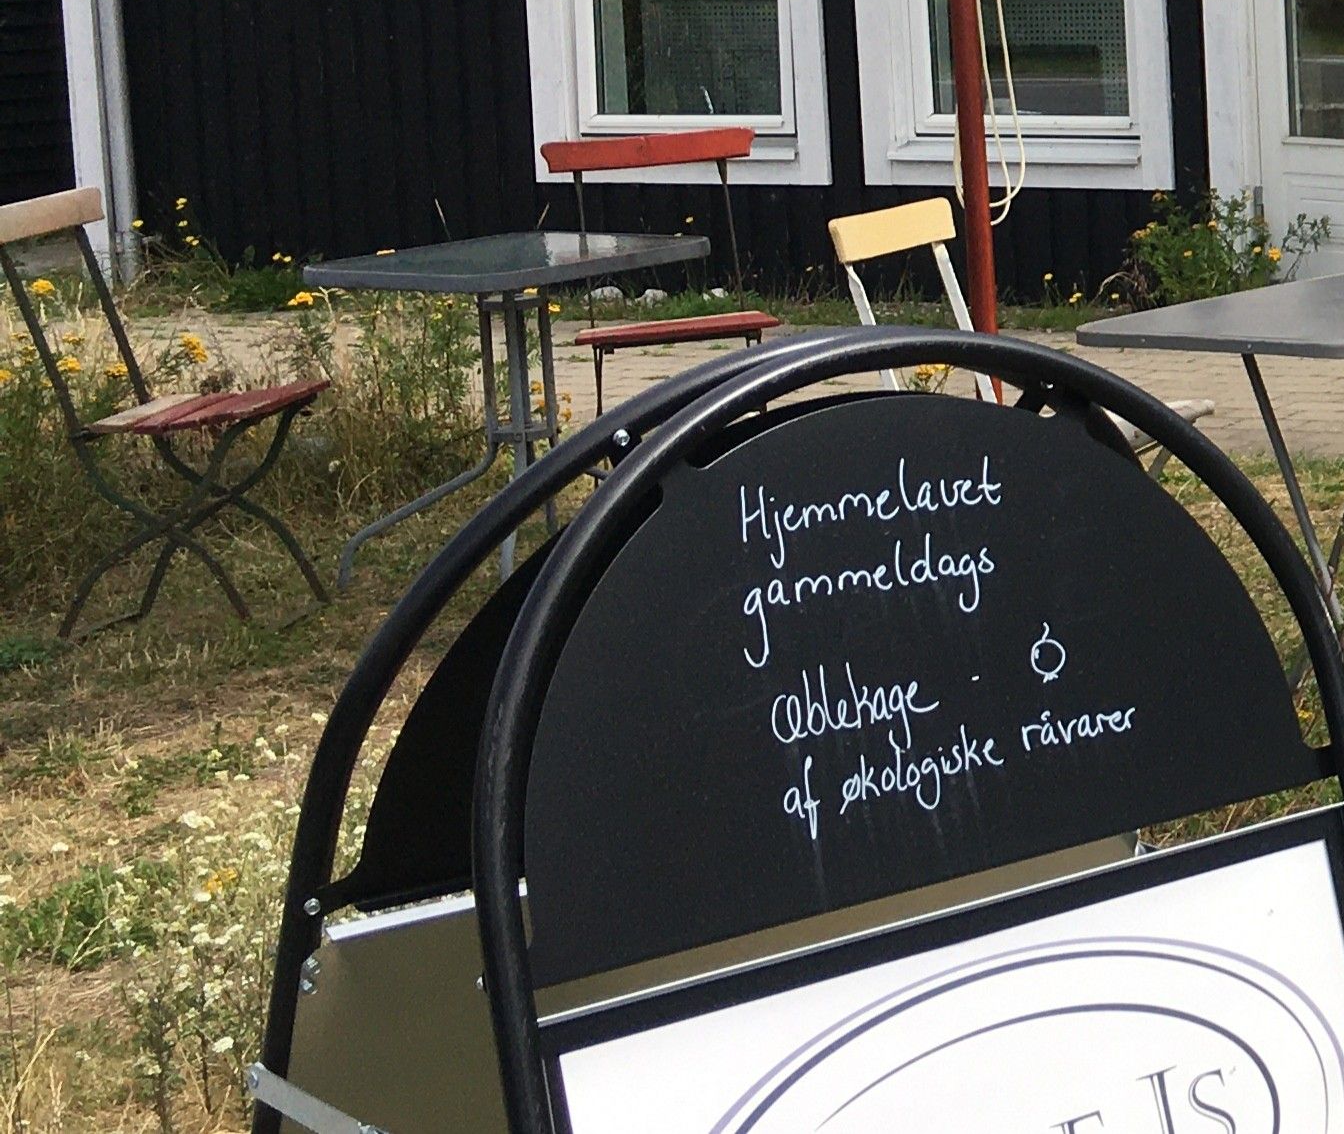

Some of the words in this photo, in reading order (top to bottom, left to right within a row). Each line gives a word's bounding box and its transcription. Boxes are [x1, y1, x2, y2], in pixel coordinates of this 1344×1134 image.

[740, 456, 1001, 568] Hjemmelavet
[742, 534, 995, 667] gammeldags
[783, 756, 819, 840] af
[839, 724, 1004, 809] økologiske
[1021, 706, 1136, 752] råvarer
